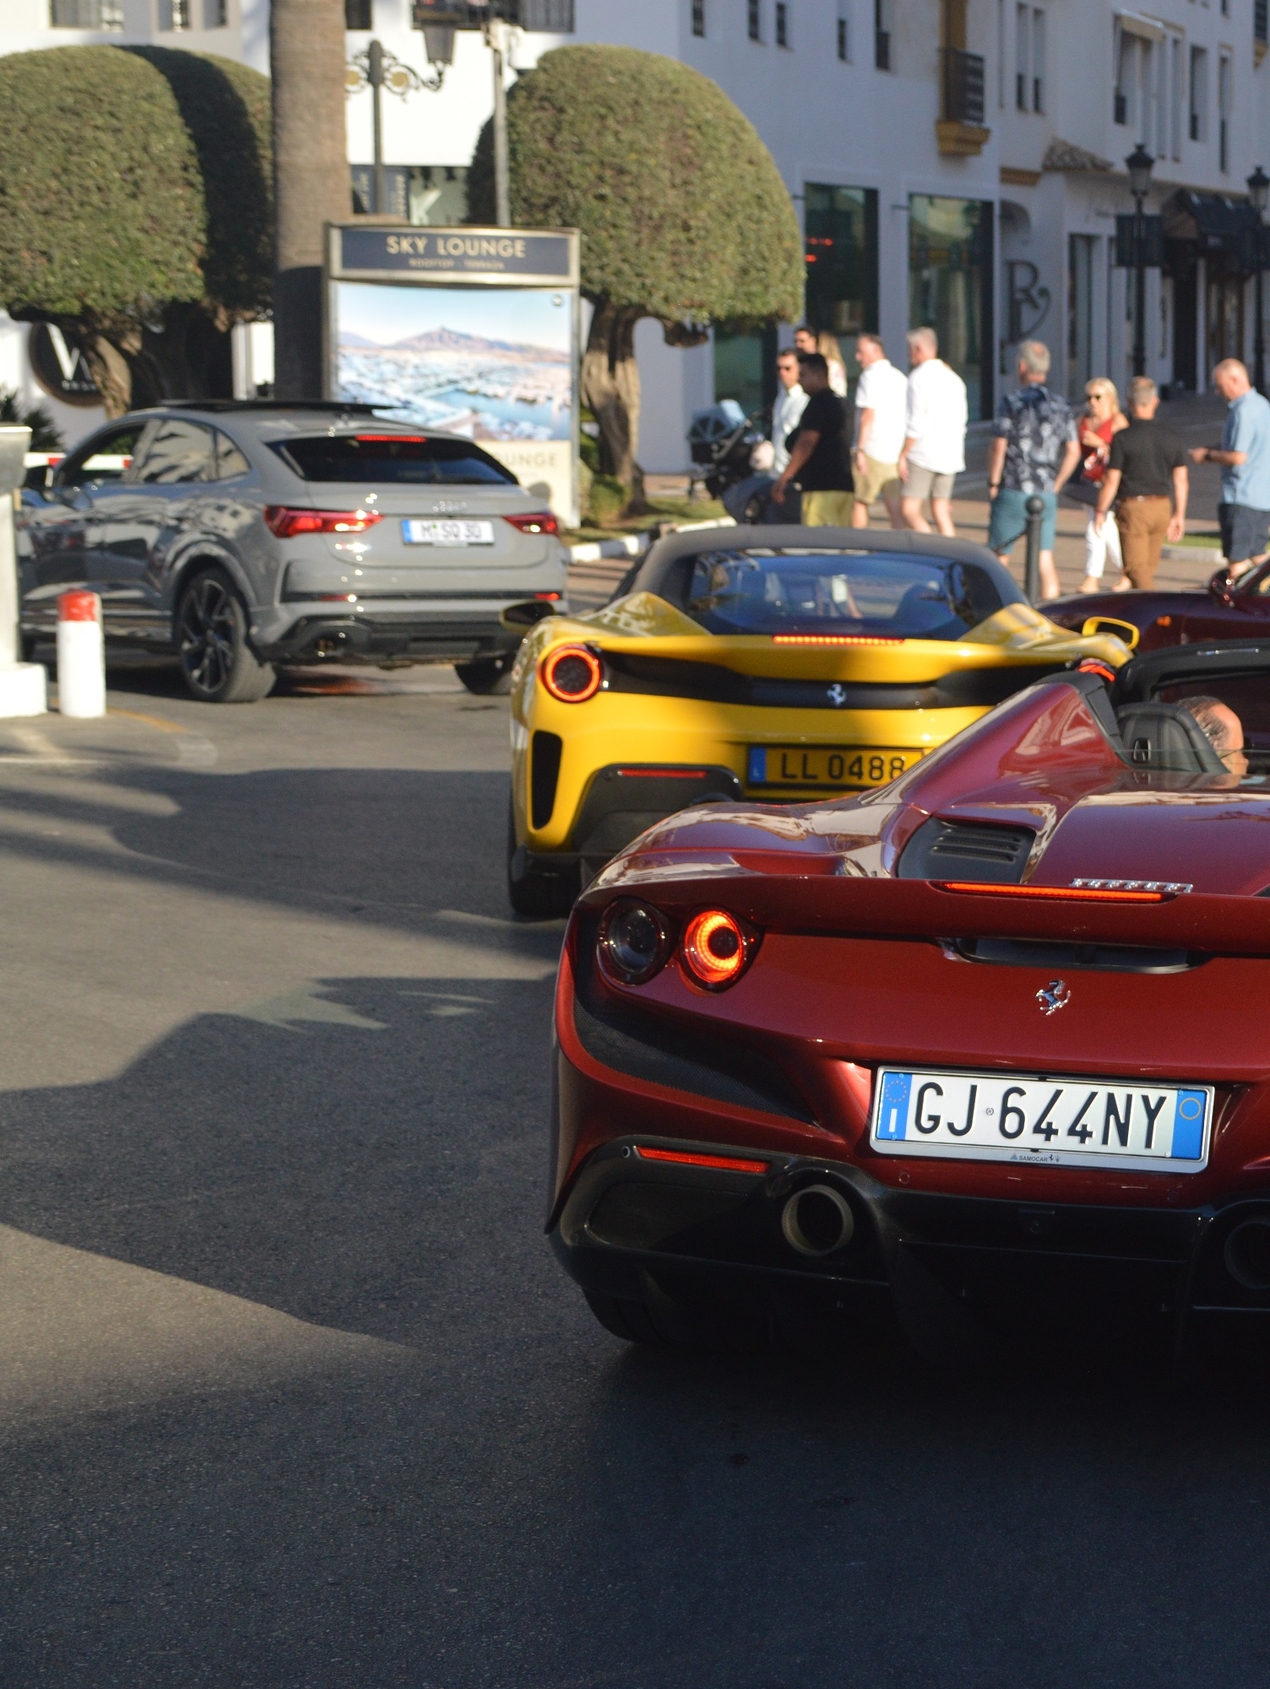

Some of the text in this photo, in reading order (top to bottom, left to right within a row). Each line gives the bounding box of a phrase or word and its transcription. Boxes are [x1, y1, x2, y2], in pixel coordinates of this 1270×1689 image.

[386, 235, 526, 258] SKY LOUNGE
[781, 752, 817, 779] LL
[1018, 1154, 1049, 1163] SAMOCAR
